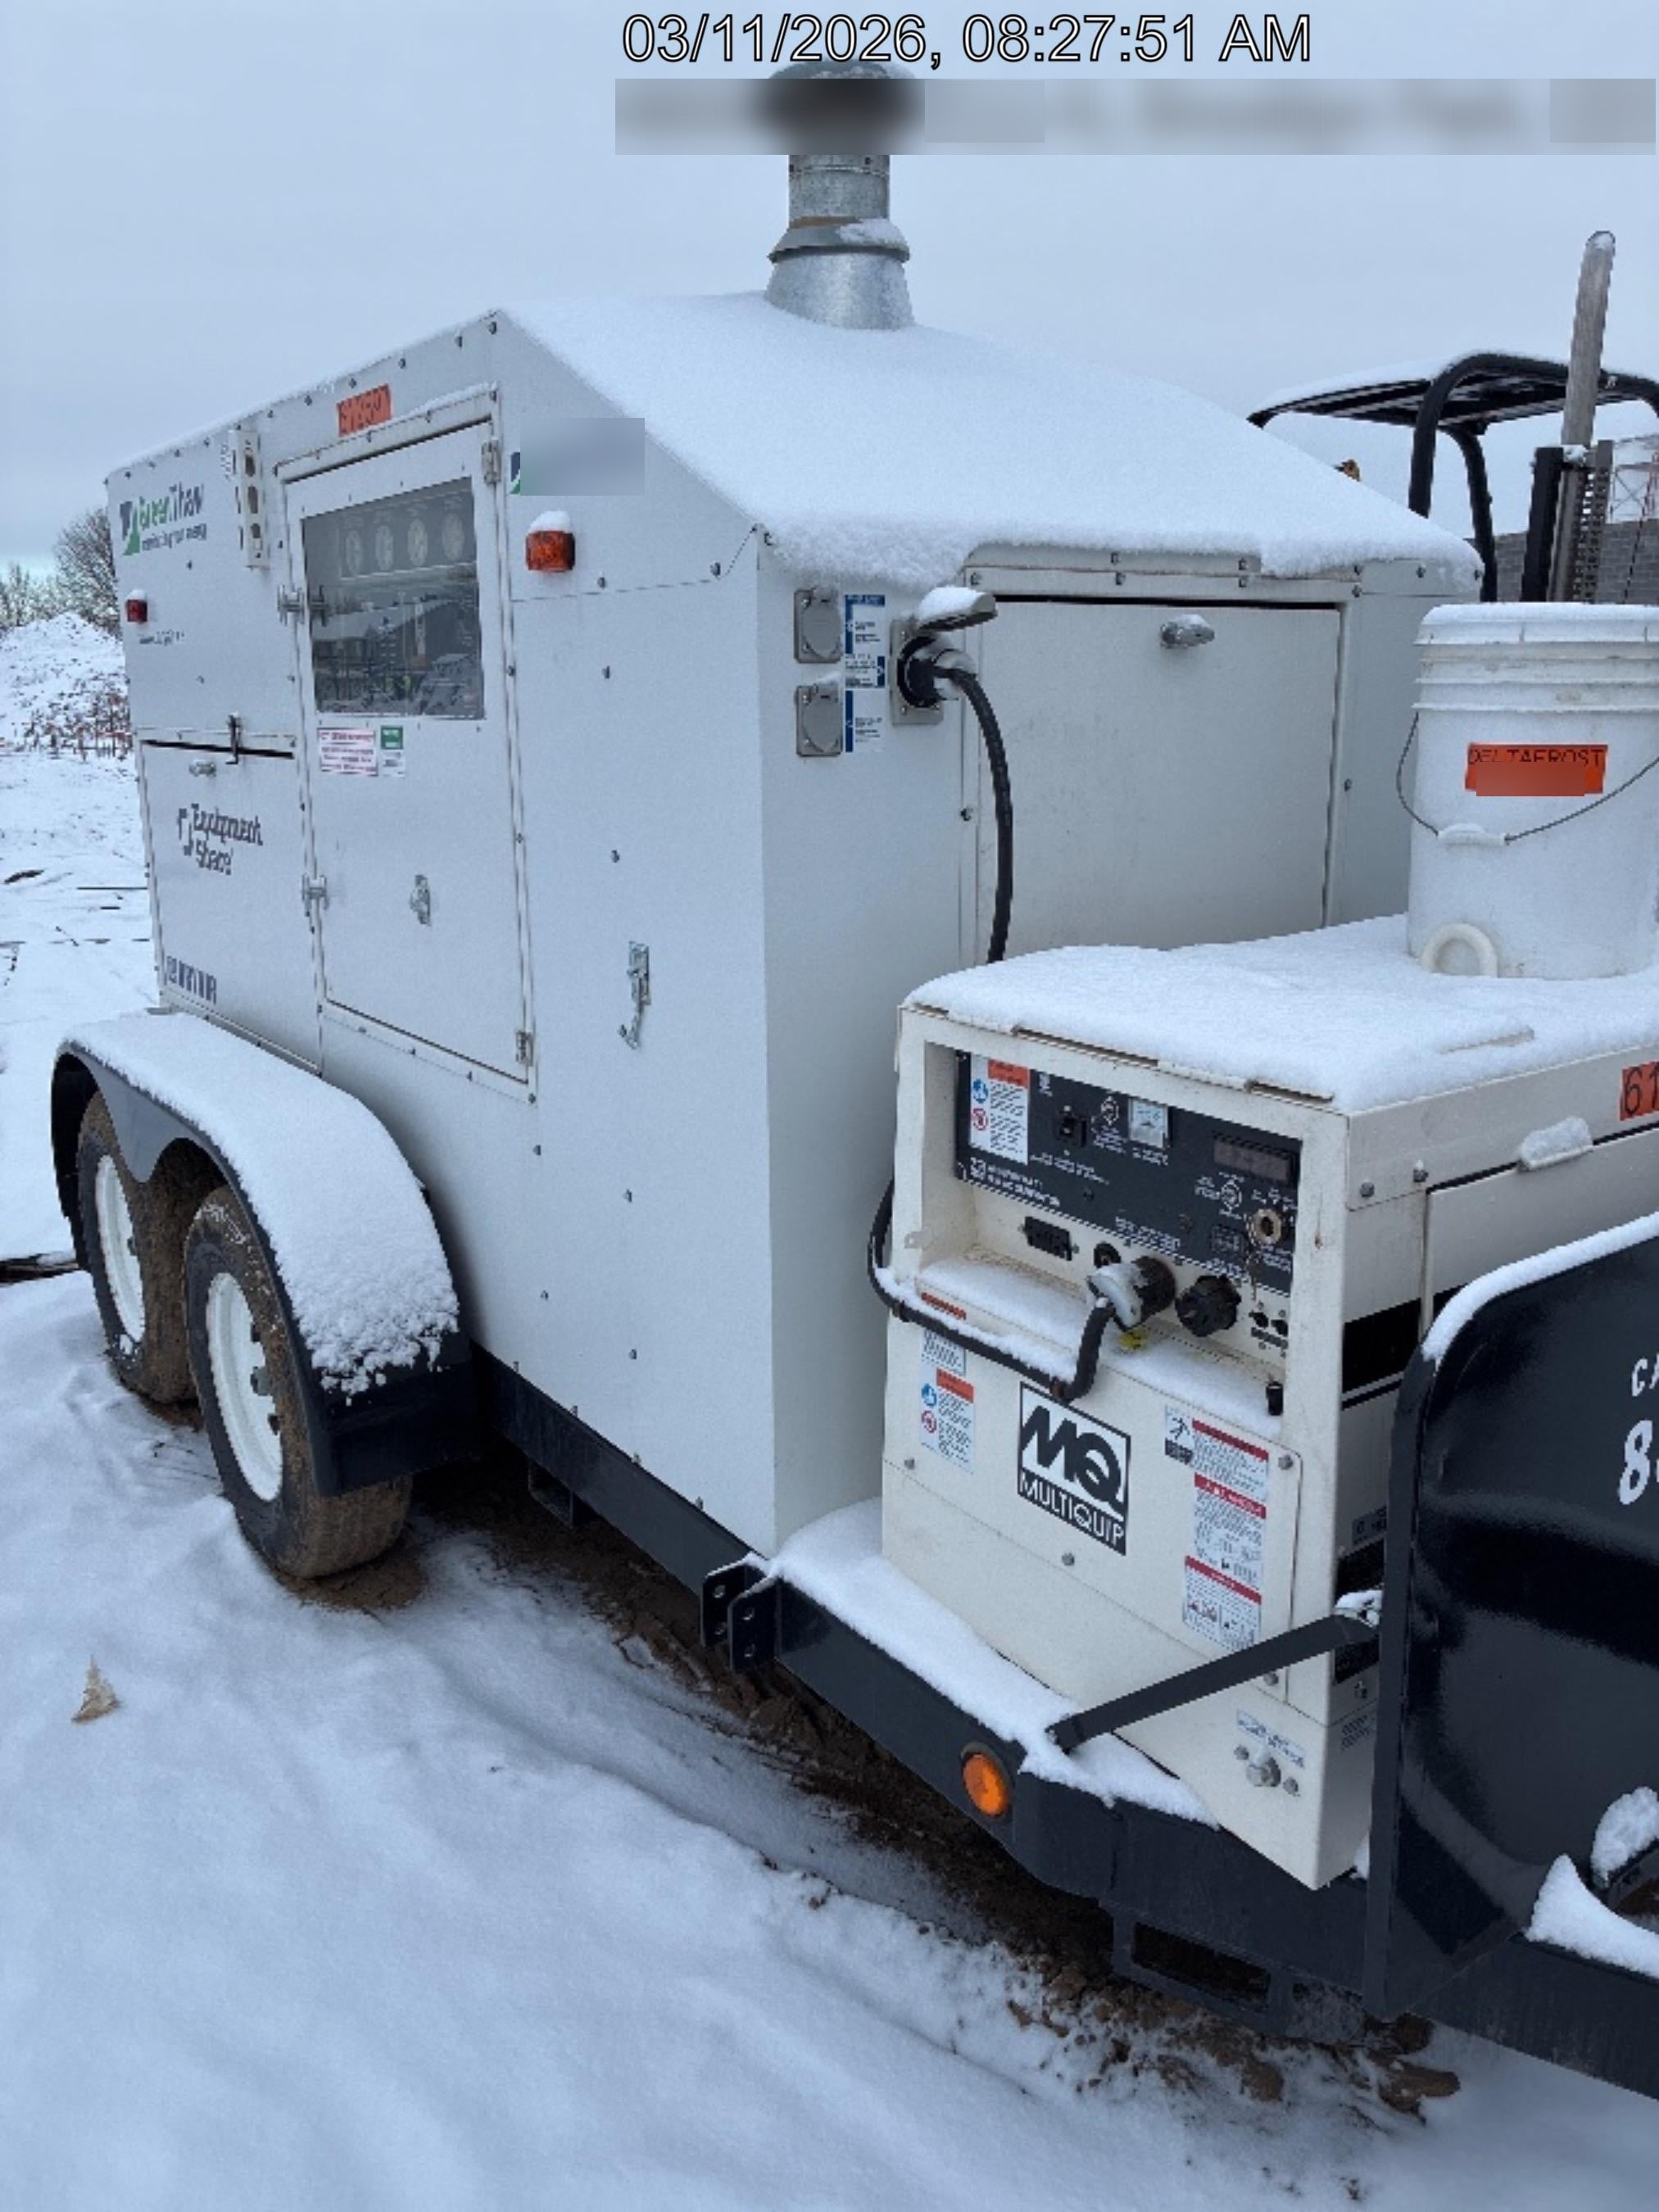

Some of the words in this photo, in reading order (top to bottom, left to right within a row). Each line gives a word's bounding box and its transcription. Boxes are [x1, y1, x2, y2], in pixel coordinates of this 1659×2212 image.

[1021, 1404, 1129, 1516] MQ
[1619, 1419, 1659, 1506] 8
[1019, 1471, 1125, 1547] MULTIQUIP
